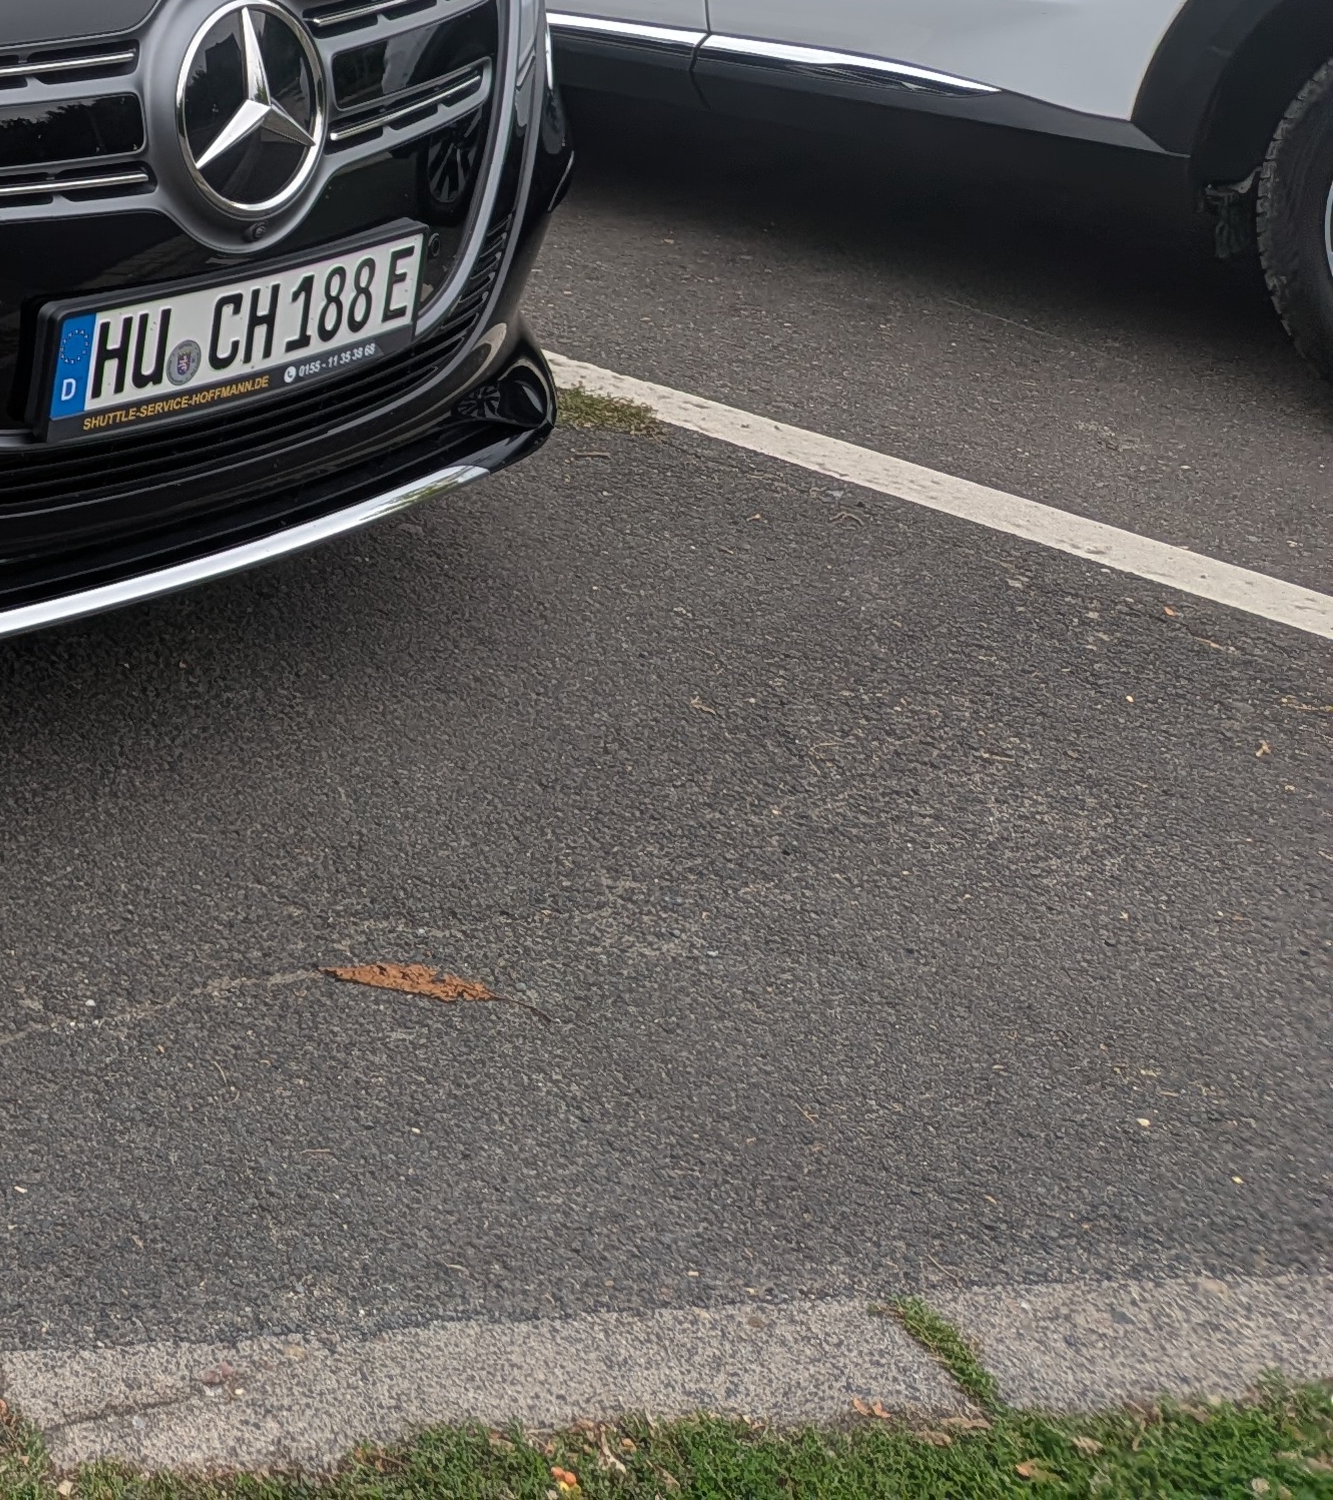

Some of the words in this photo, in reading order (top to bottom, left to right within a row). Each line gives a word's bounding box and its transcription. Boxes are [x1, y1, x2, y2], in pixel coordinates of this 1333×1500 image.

[61, 378, 77, 401] D
[91, 308, 171, 399] HU
[299, 360, 321, 377] 0155
[328, 355, 338, 368] 11
[83, 375, 269, 431] SHUTTLE-SERVICE-HOFFMANN.DE
